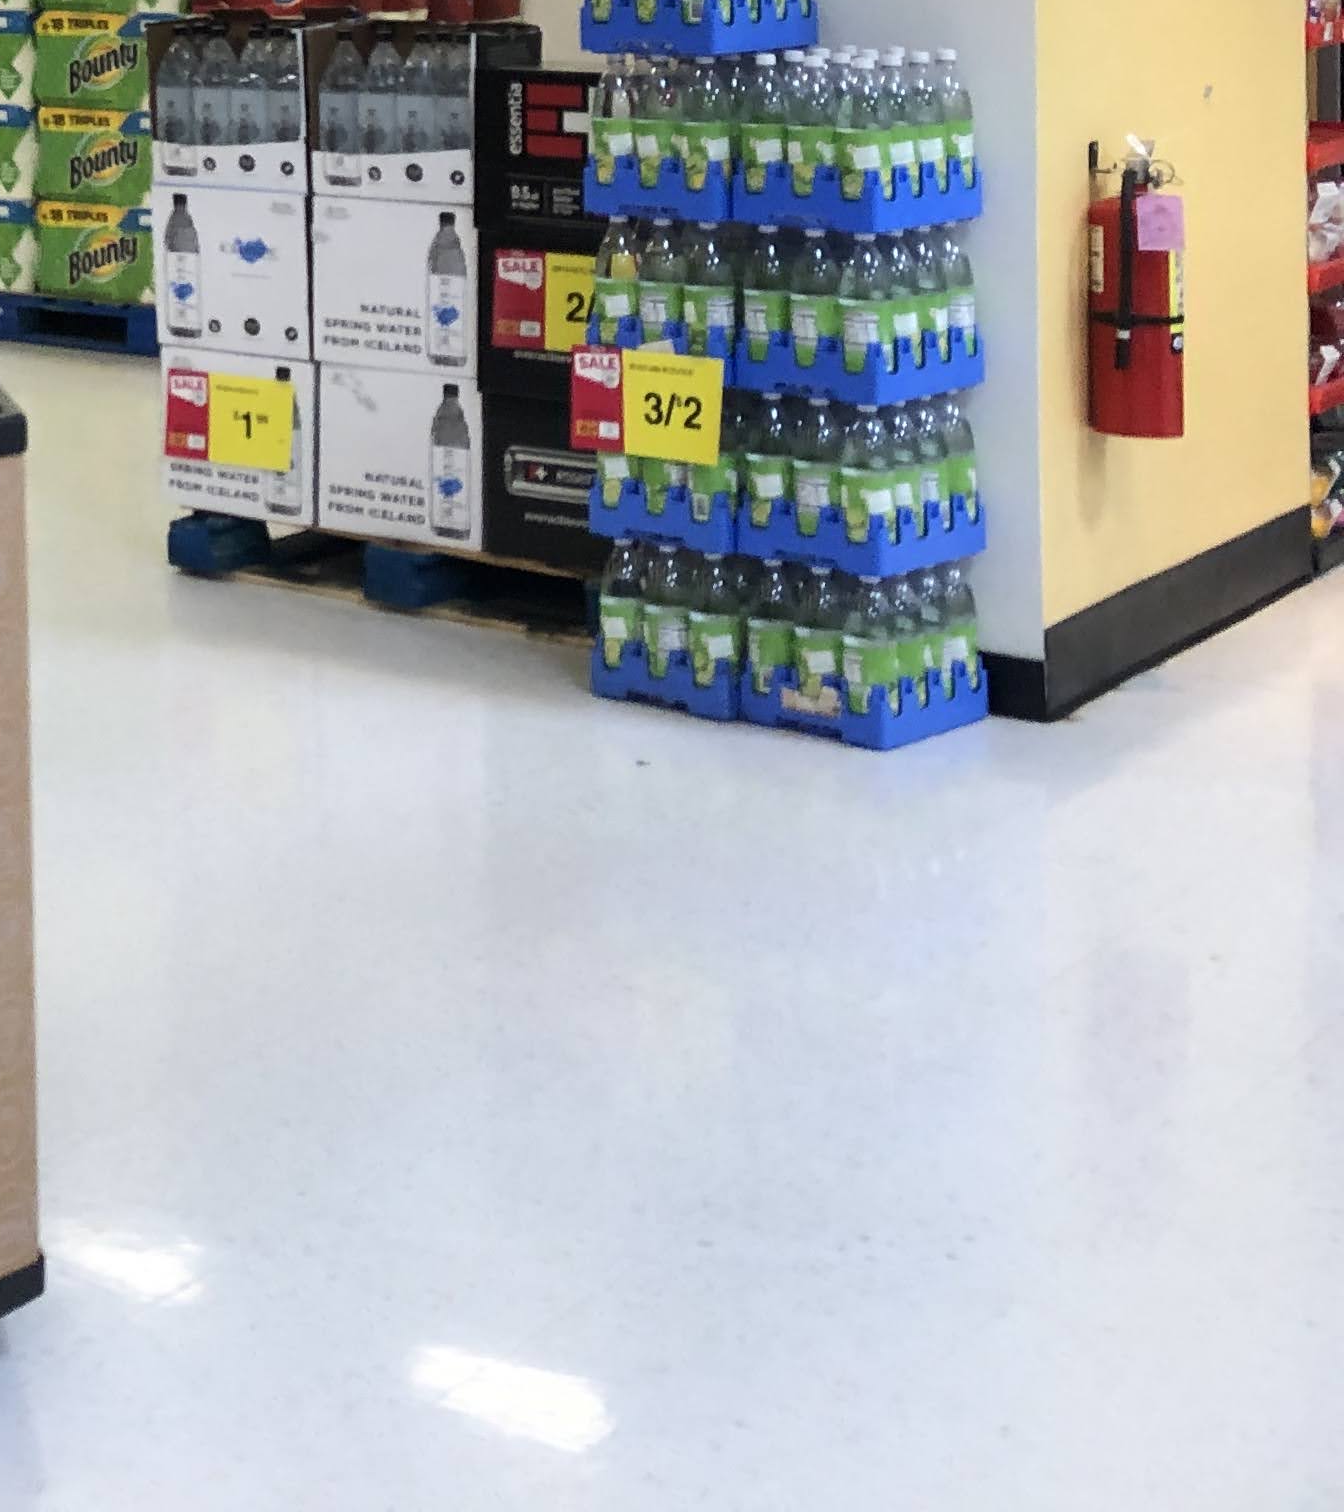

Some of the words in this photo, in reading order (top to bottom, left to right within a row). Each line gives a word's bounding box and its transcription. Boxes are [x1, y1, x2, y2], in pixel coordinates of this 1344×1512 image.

[68, 17, 110, 31] TRIPLES
[68, 42, 139, 95] Bounty
[69, 114, 110, 128] TRIPLES
[508, 82, 523, 156] essentia
[69, 138, 139, 190] Bounty
[67, 209, 109, 224] TRIPLES
[68, 235, 139, 286] Bounty
[501, 259, 539, 273] SALE
[360, 304, 421, 319] NATURAL
[324, 318, 373, 333] SPRING
[377, 321, 422, 337] WATER
[324, 334, 361, 349] FROM
[365, 338, 422, 355] ICELAND
[578, 354, 618, 370] SALE
[217, 469, 260, 484] WATER
[365, 471, 424, 489] NATURAL
[169, 478, 203, 493] FROM
[207, 484, 260, 502] ICELAND
[329, 484, 377, 502] SPRING
[380, 489, 425, 507] WATER
[328, 501, 365, 516] FROM
[369, 506, 426, 526] ICELAND
